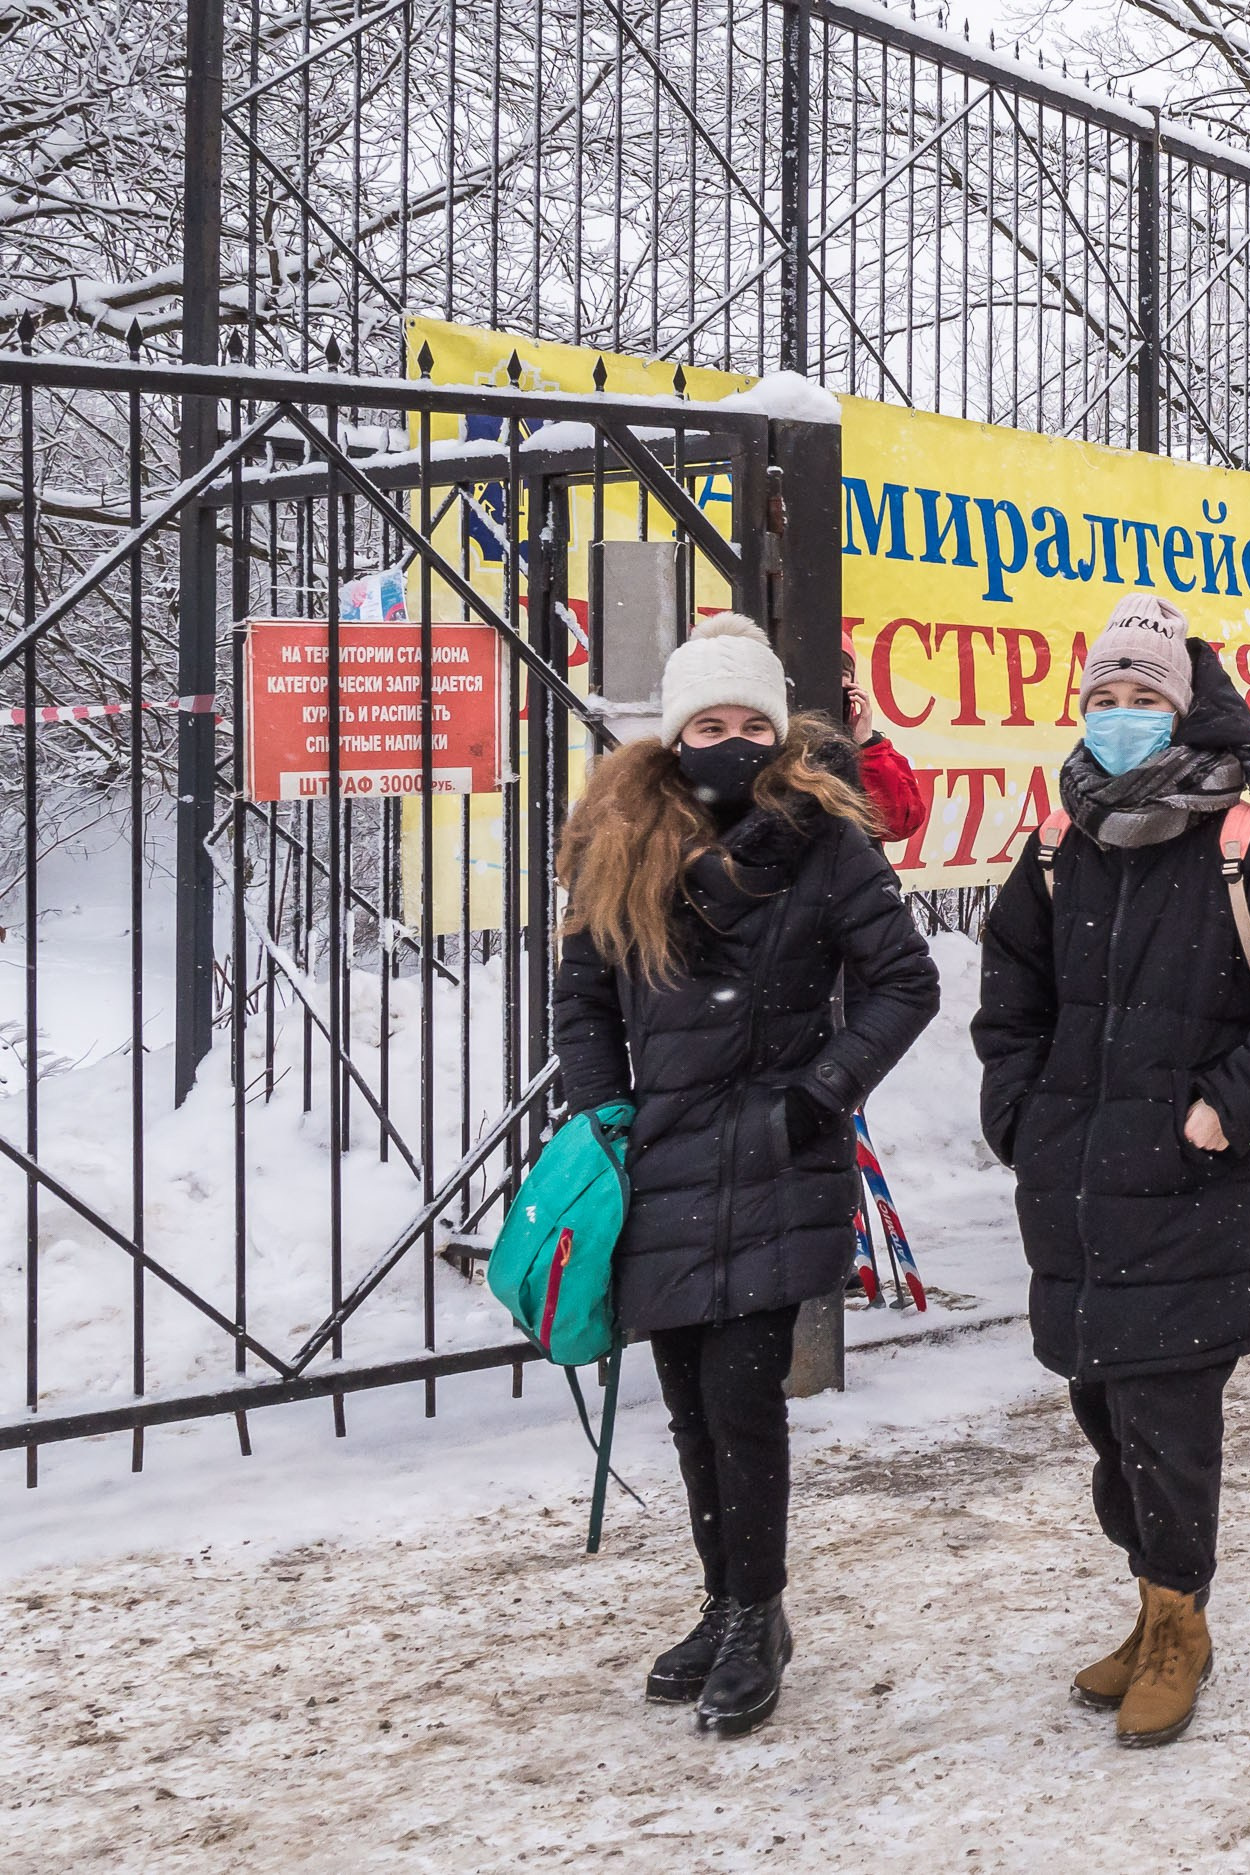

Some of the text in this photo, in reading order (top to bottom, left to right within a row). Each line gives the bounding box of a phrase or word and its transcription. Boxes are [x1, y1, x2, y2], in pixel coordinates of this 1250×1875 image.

[281, 646, 470, 665] НА ТЕРИТОРИИ СТАИОНА
[267, 675, 483, 695] КАТЕГОРЧЕСКИ ЗАПРЩАЕТСЯ
[302, 704, 451, 723] КУРТЬ И РАСПИВТЬ
[385, 734, 448, 751] НАПИКИ
